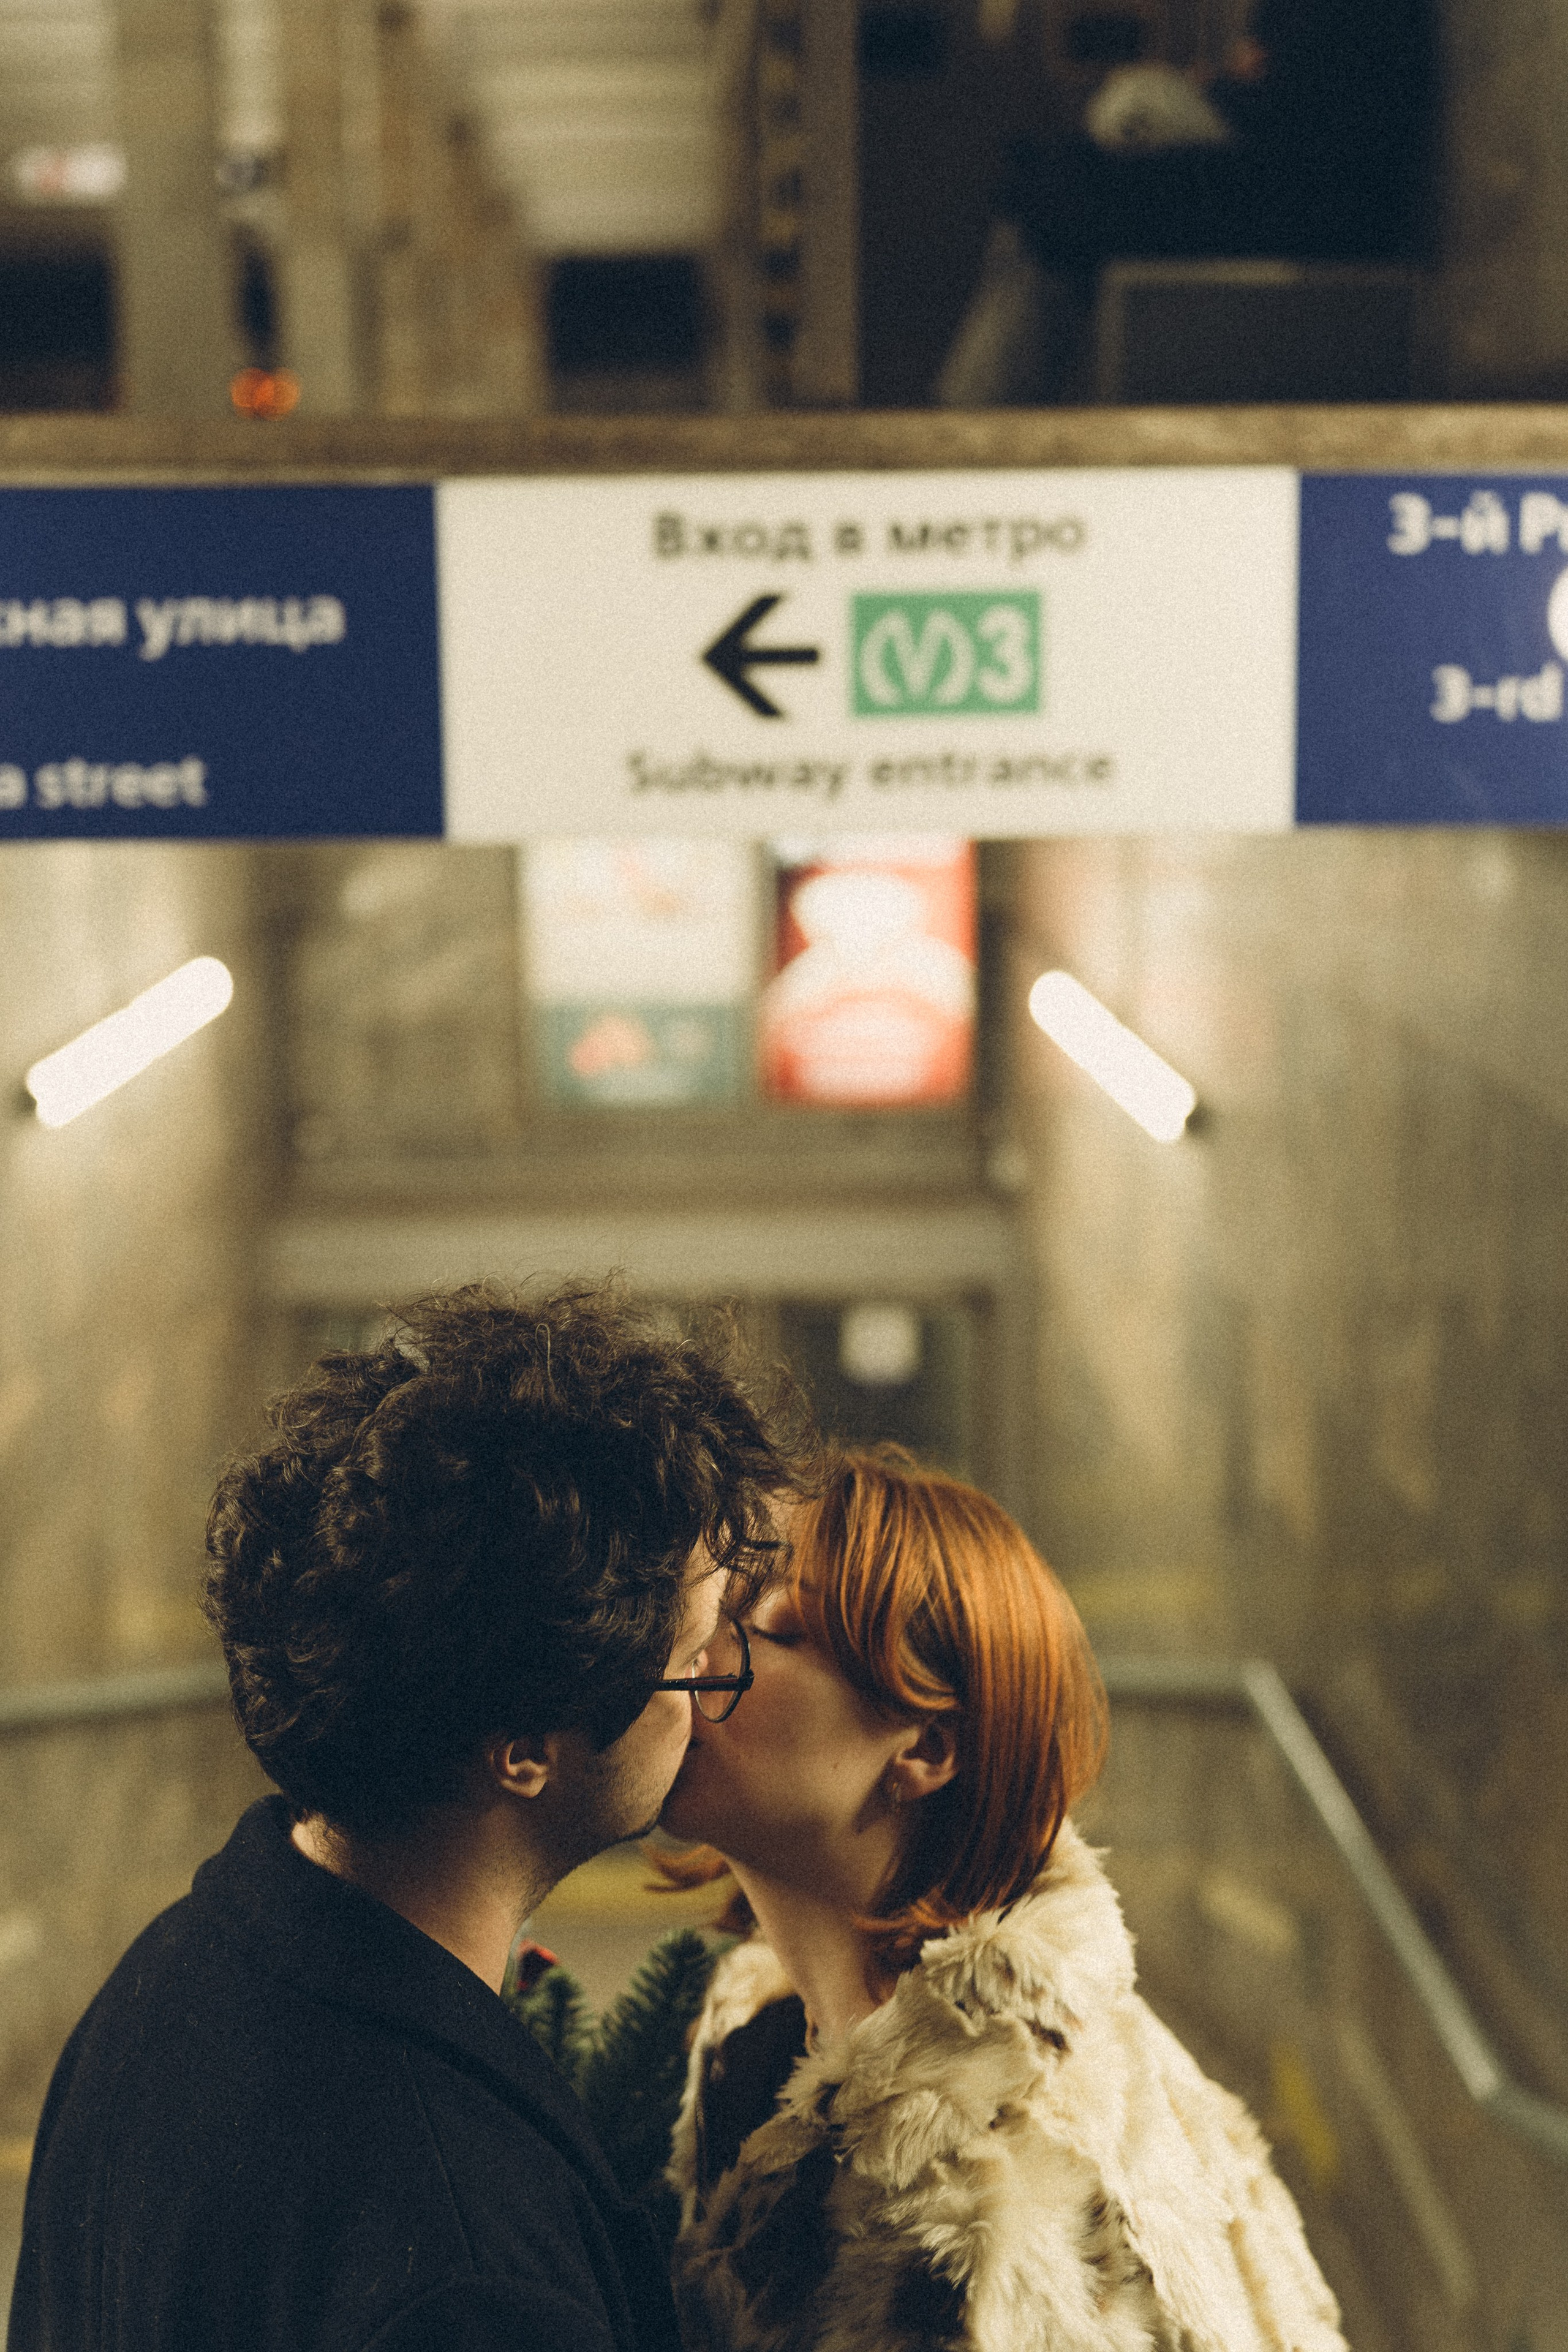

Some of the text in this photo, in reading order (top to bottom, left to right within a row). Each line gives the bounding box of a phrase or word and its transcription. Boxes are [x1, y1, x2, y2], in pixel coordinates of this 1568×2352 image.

[654, 513, 1084, 563] Вход в метро
[1519, 492, 1568, 555] Р
[0, 596, 346, 661] ная улица
[1432, 660, 1564, 723] 3-rd
[36, 756, 208, 809] street
[627, 750, 1110, 801] Subway entrance
